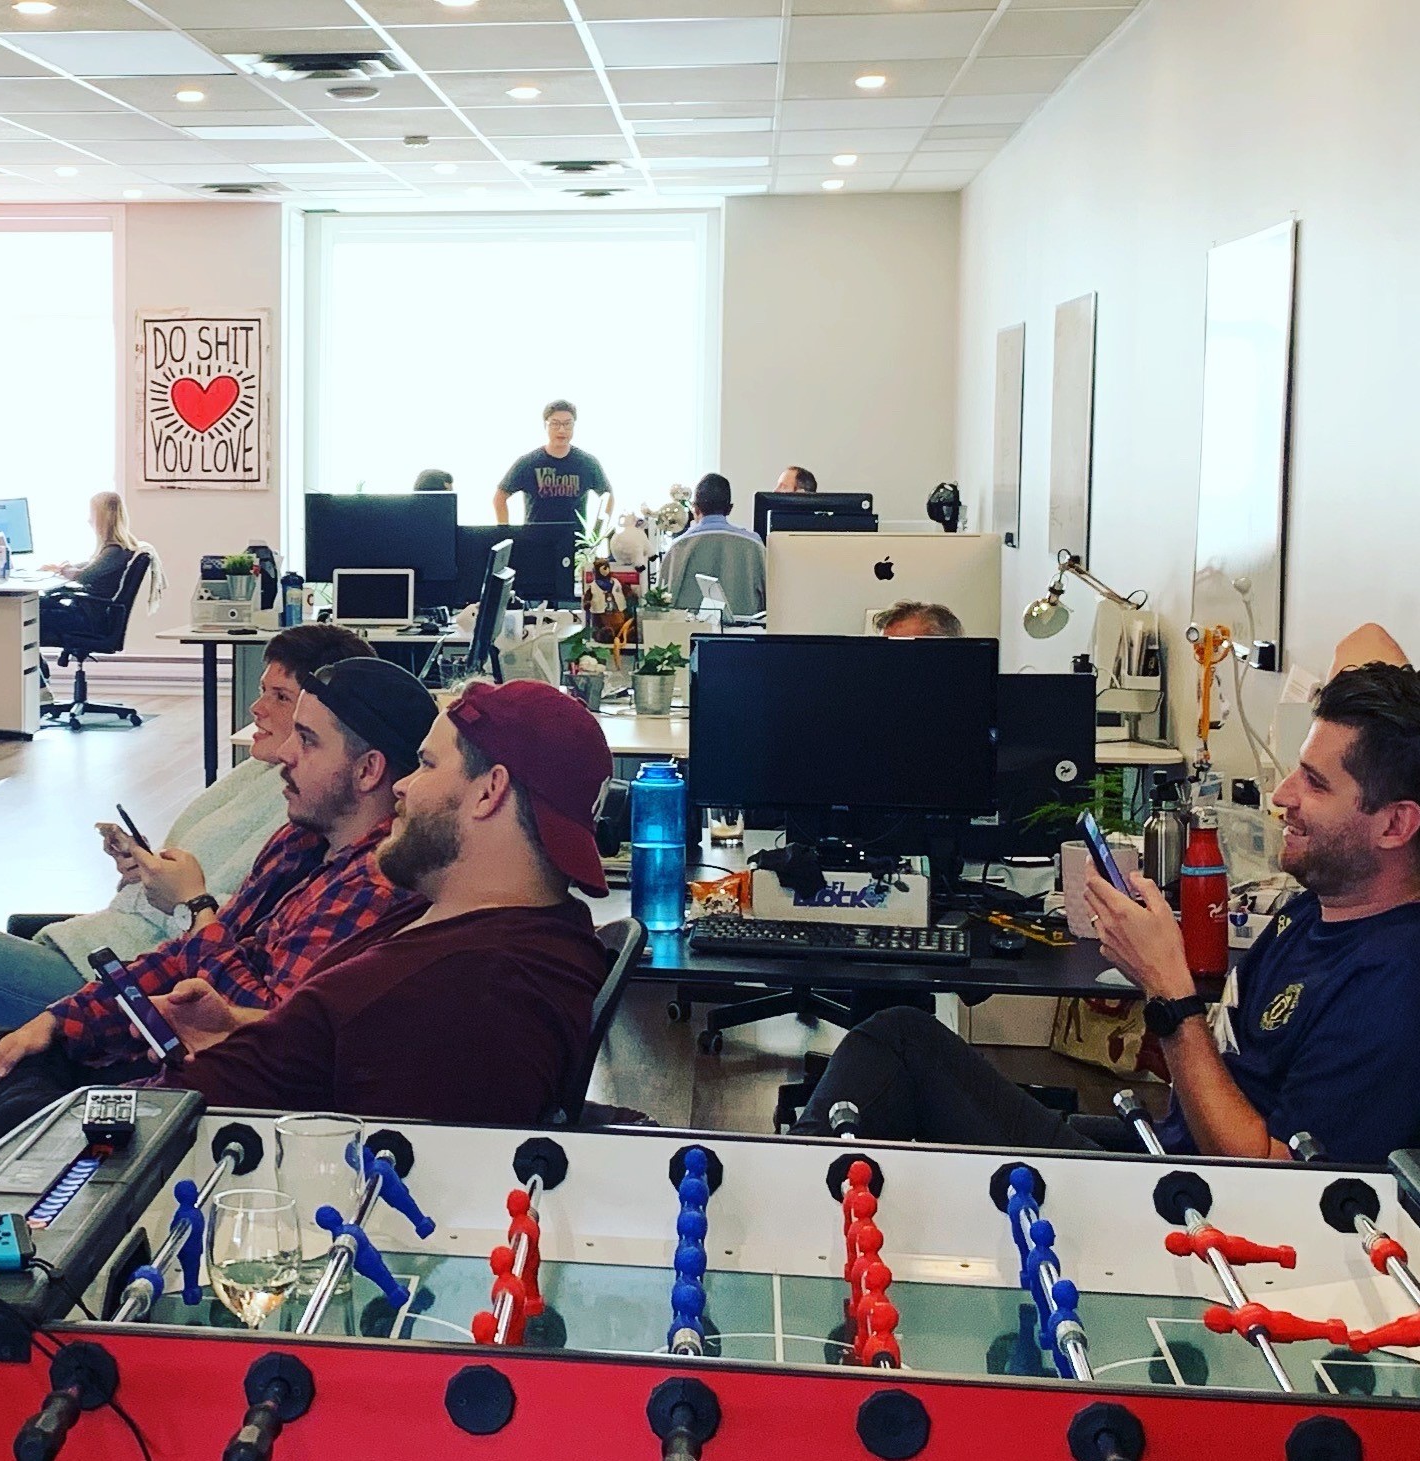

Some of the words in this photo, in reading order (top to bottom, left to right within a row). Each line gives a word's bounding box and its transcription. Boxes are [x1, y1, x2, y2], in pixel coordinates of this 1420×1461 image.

[153, 326, 186, 369] DO
[197, 326, 254, 368] SHIT
[151, 420, 193, 472] YOU
[201, 418, 253, 472] LOVE
[534, 467, 580, 488] Volcom
